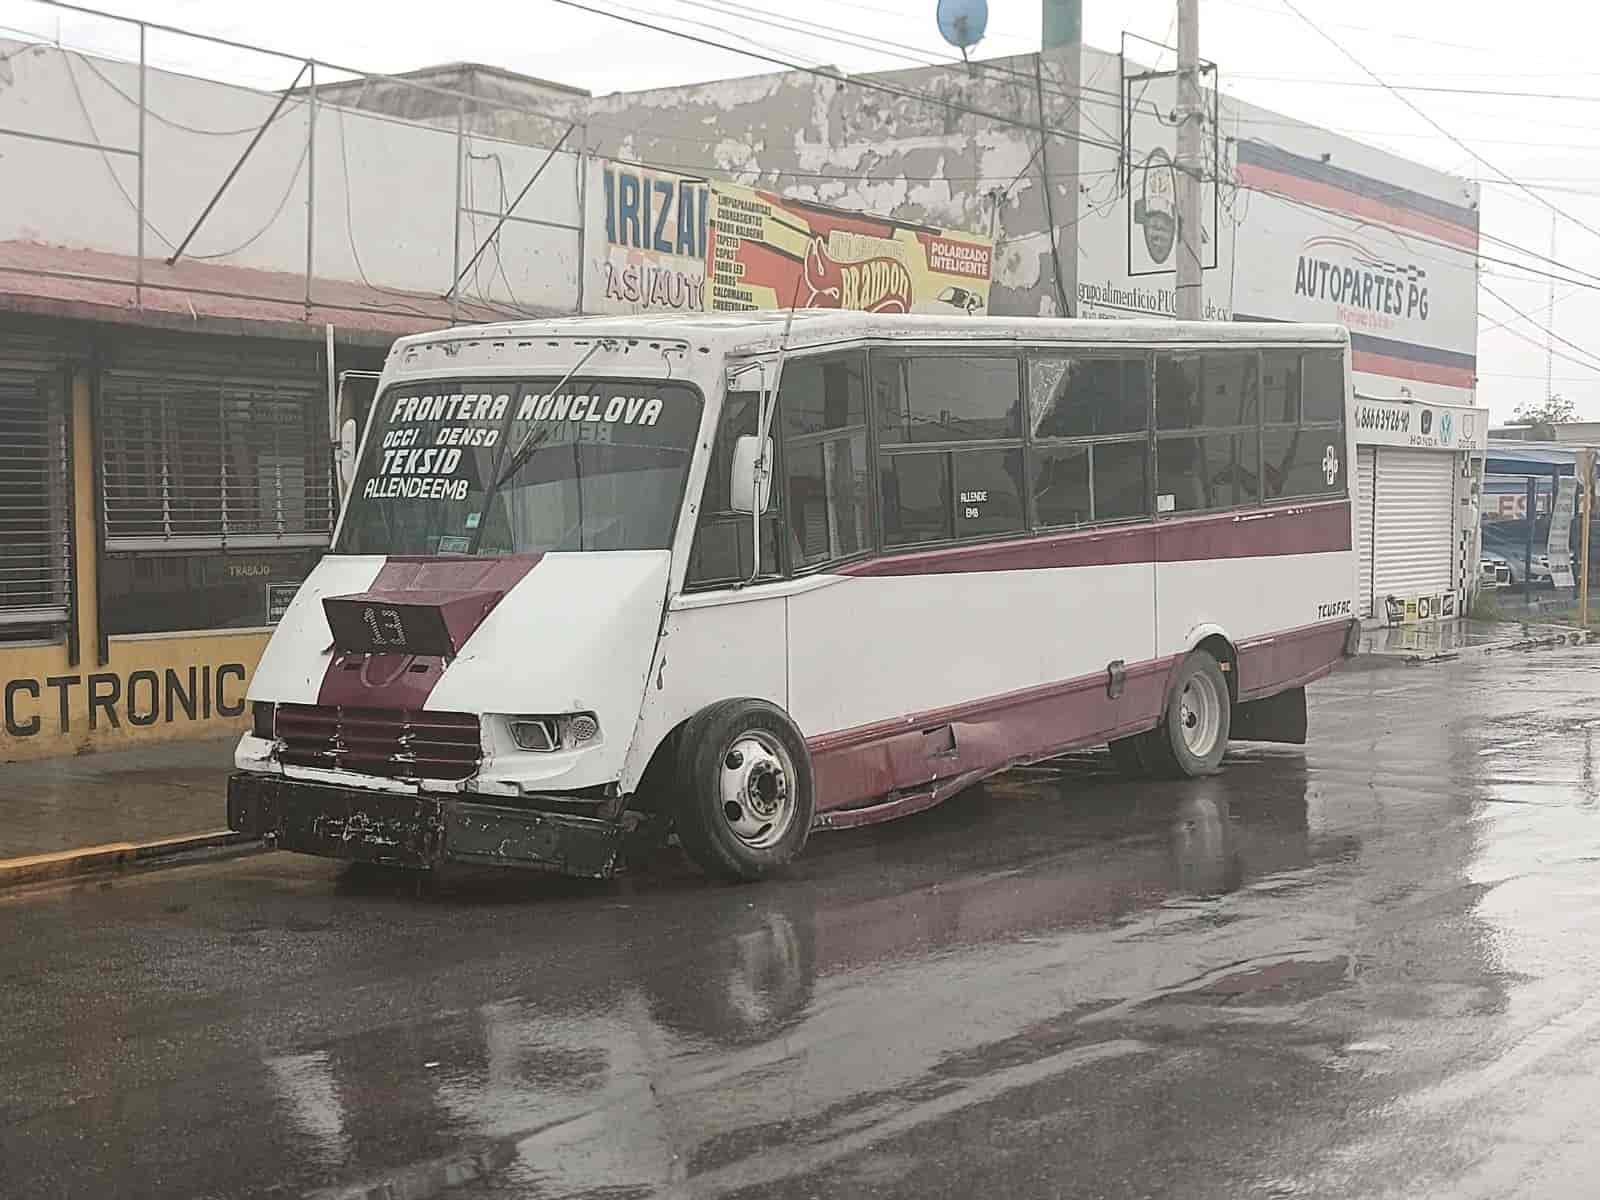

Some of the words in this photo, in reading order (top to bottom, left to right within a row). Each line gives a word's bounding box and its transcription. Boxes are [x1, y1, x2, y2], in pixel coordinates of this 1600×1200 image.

[931, 241, 989, 263] POLARIZADO
[930, 255, 989, 277] INTELIGENTE
[1101, 280, 1156, 310] alimenticio
[1295, 255, 1401, 316] AUTOPARTES
[1407, 284, 1428, 321] PG
[390, 394, 509, 424] FRONTERA
[516, 394, 664, 426] MONCLOVA
[436, 426, 500, 448] DENSO
[380, 448, 462, 475] TEKSID
[363, 477, 469, 501] ALLENDEEMB
[960, 490, 989, 503] ALLENDE
[363, 608, 407, 647] 13
[4, 663, 246, 737] CTRONIC
